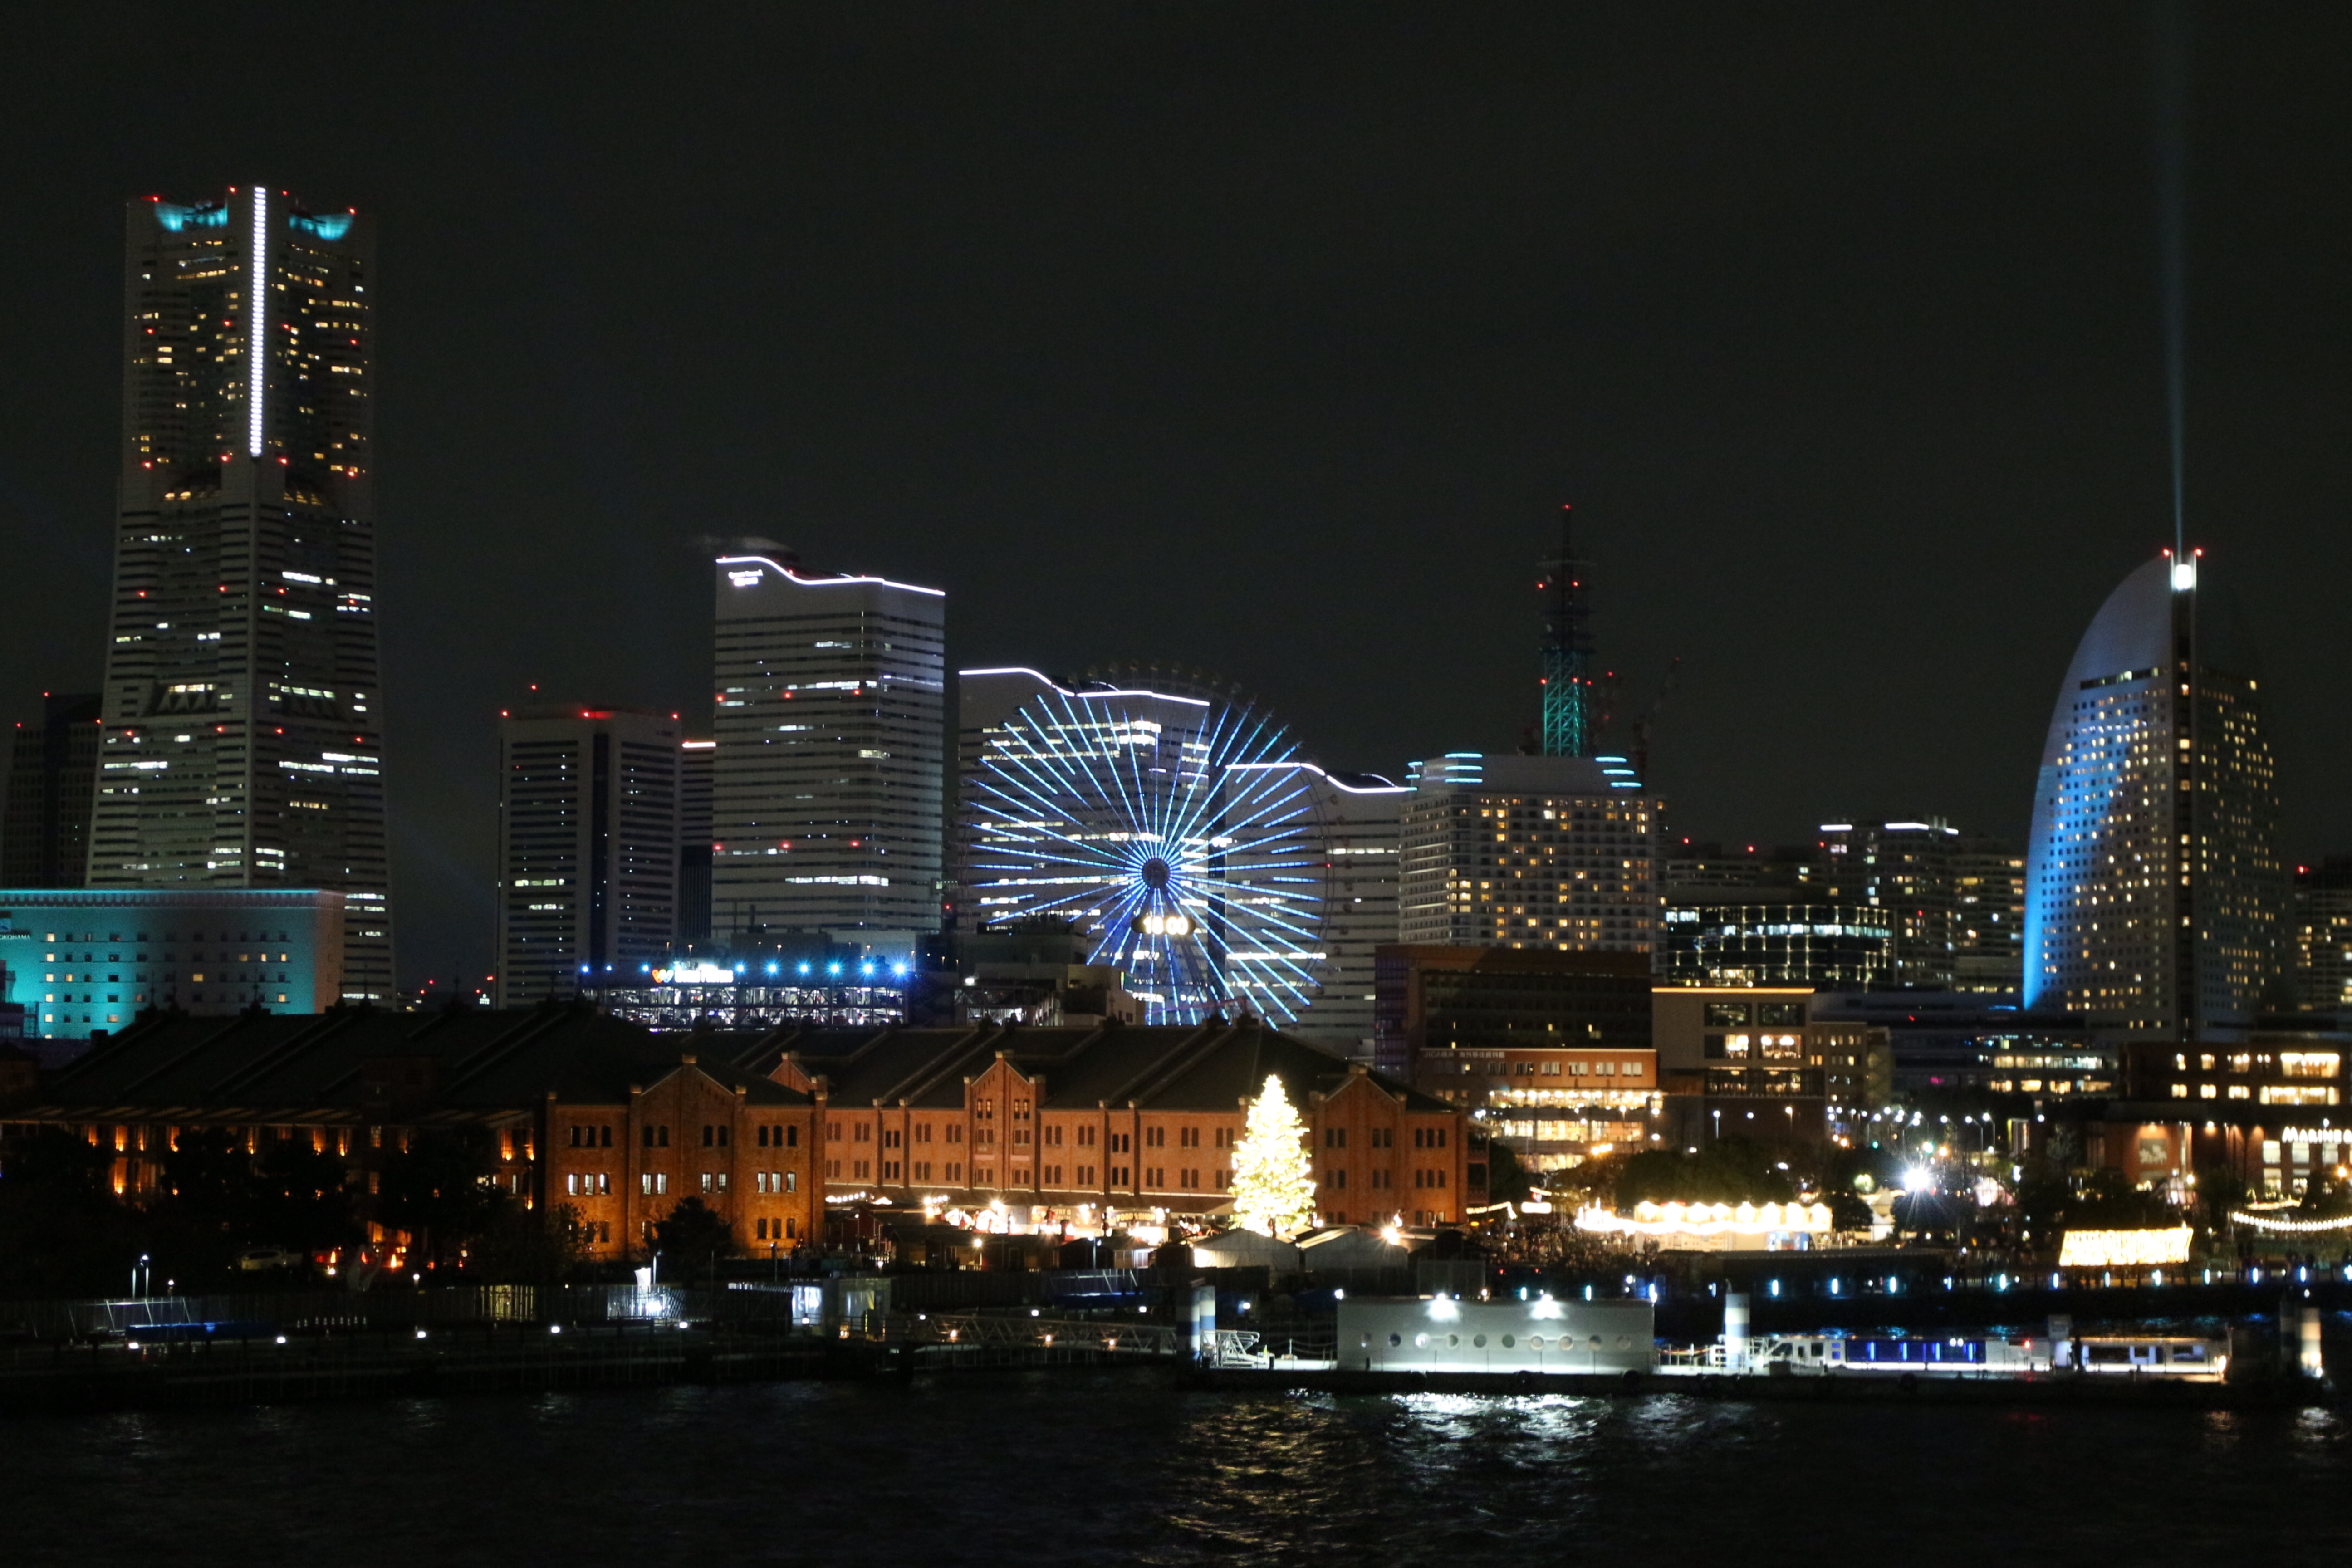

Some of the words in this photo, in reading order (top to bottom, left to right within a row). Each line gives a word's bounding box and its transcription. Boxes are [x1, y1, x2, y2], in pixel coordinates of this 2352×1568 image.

[2282, 1127, 2342, 1144] MARINE
[1117, 1213, 1133, 1222] FOOD
[1138, 1213, 1156, 1221] SHOP
